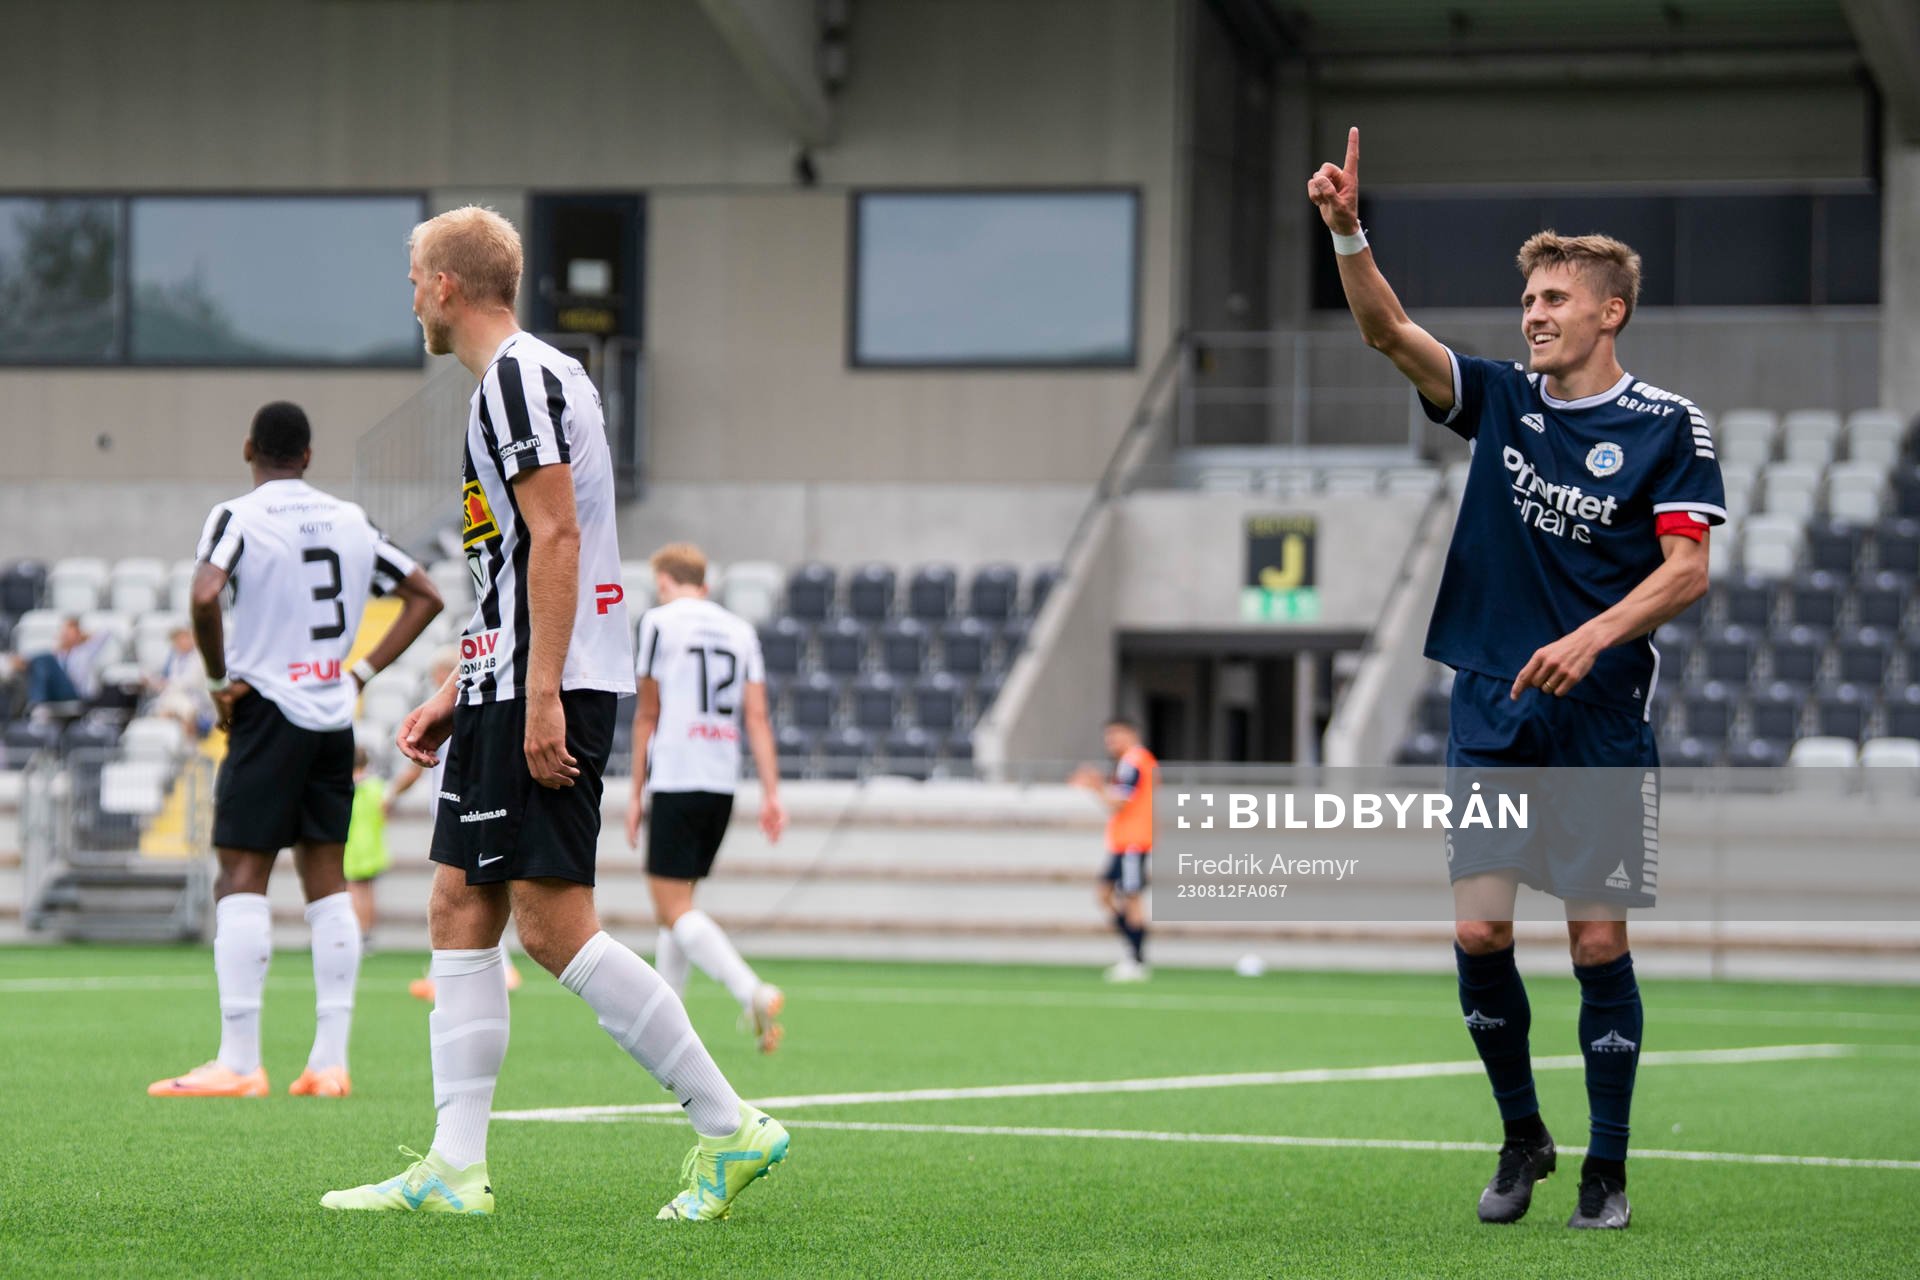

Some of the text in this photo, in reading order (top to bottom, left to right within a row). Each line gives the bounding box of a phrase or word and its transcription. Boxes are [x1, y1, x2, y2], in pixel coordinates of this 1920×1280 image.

[500, 437, 540, 460] stadium
[1258, 532, 1305, 591] J
[302, 546, 346, 641] 3
[483, 657, 497, 671] AB
[687, 646, 737, 715] 12
[1605, 878, 1631, 890] SELECT
